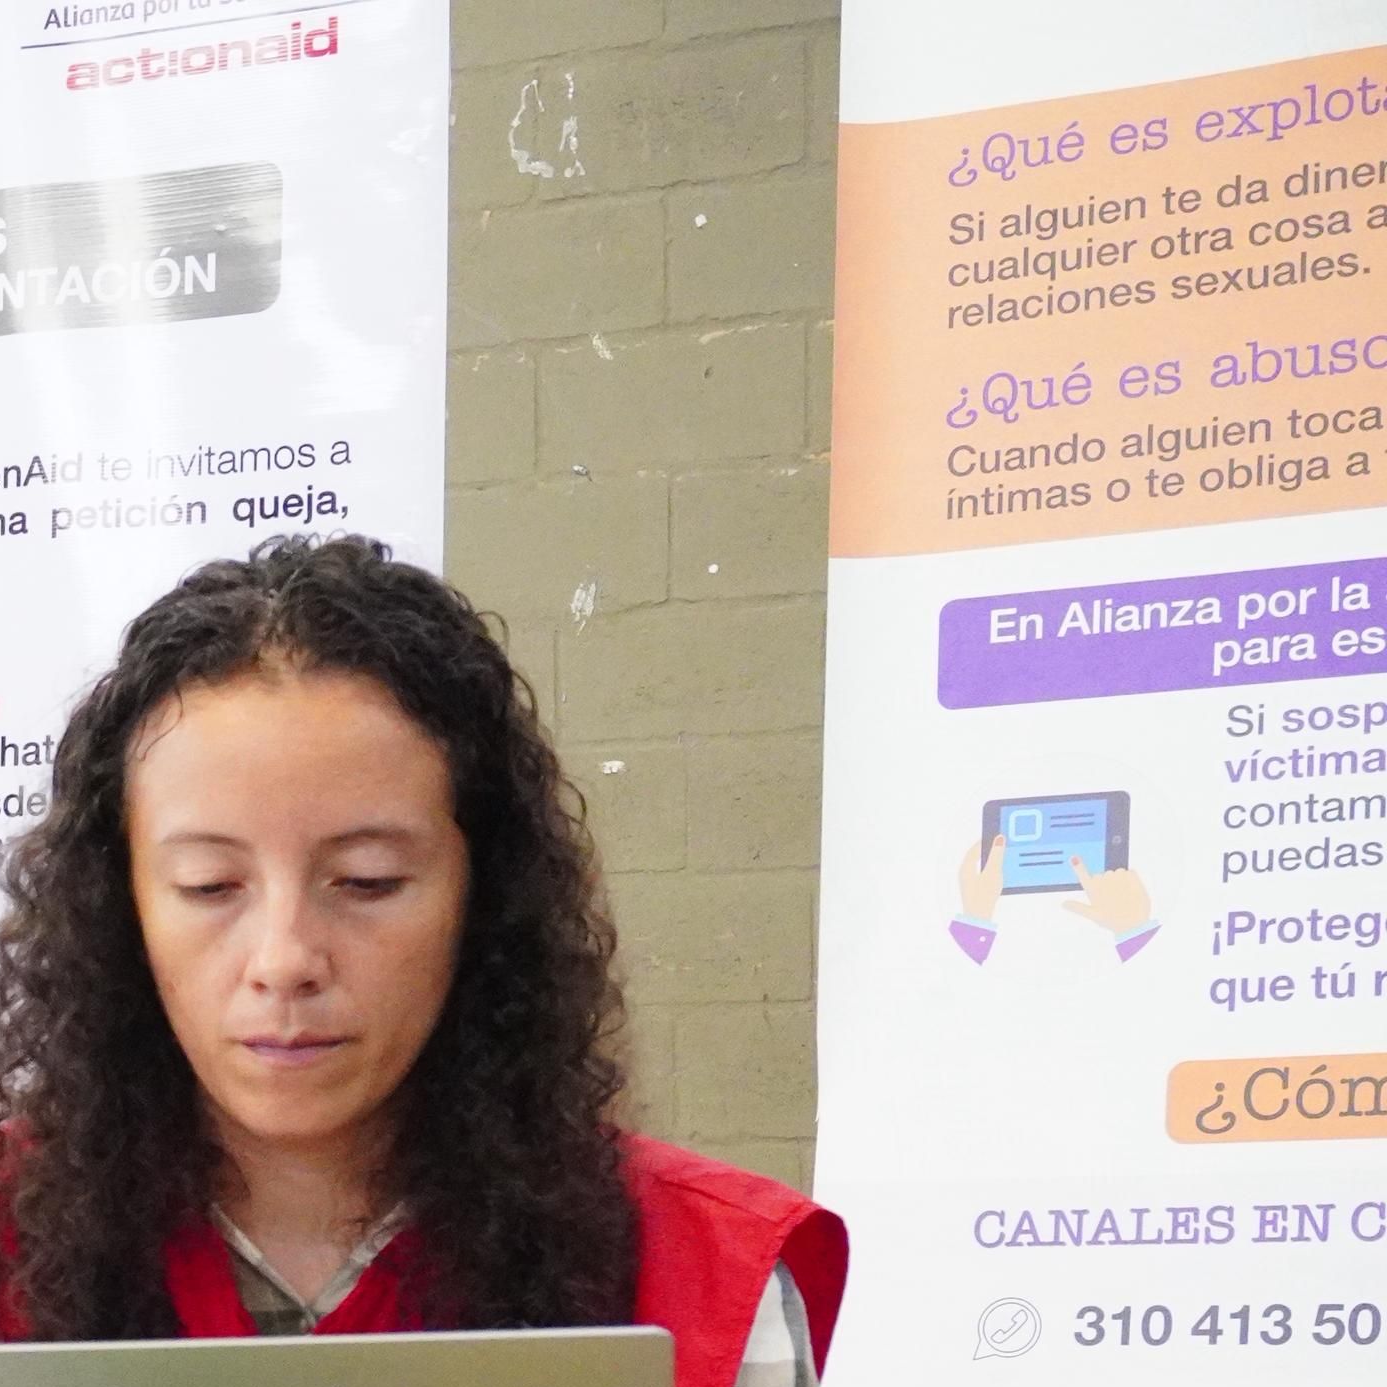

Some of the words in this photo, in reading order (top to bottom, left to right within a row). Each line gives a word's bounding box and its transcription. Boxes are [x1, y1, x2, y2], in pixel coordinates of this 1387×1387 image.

[43, 2, 135, 30] Alianza
[947, 121, 1086, 188] ¿Qué
[1109, 116, 1170, 154] es
[1194, 75, 1387, 143] explot
[948, 211, 986, 245] Si
[1000, 192, 1146, 243] alguien
[1162, 186, 1202, 214] te
[1216, 174, 1269, 209] da
[947, 236, 1136, 288] cualquier
[1150, 224, 1233, 259] otra
[1248, 206, 1351, 246] cosa
[947, 276, 1156, 329] relaciones
[1170, 251, 1371, 301] sexuales.
[945, 362, 1092, 429] ¿Qué
[1119, 358, 1182, 399] es
[98, 452, 132, 481] te
[147, 441, 316, 480] invitamos
[330, 440, 351, 466] a
[947, 439, 1106, 478] Cuando
[1121, 416, 1271, 463] alguien
[1287, 404, 1383, 439] toca
[946, 480, 1091, 520] íntimas
[1106, 477, 1131, 504] o
[1146, 468, 1185, 499] te
[1199, 447, 1330, 493] obliga
[1345, 450, 1371, 476] a
[51, 495, 206, 539] petición
[232, 485, 349, 527] queja,
[989, 607, 1044, 644] En
[1057, 594, 1221, 638] Alianza
[1237, 586, 1316, 629] por
[1331, 576, 1370, 613] la
[1212, 632, 1316, 676] para
[1225, 704, 1266, 738] Si
[1222, 837, 1384, 883] puedas
[1211, 907, 1387, 955] ¡Proteg
[1209, 975, 1296, 1013] que
[1311, 962, 1356, 1000] tú
[973, 1205, 1235, 1248] CANALES
[1251, 1203, 1336, 1243] EN
[1074, 1305, 1172, 1346] 310
[1191, 1304, 1293, 1346] 413
[1312, 1302, 1381, 1346] 50
